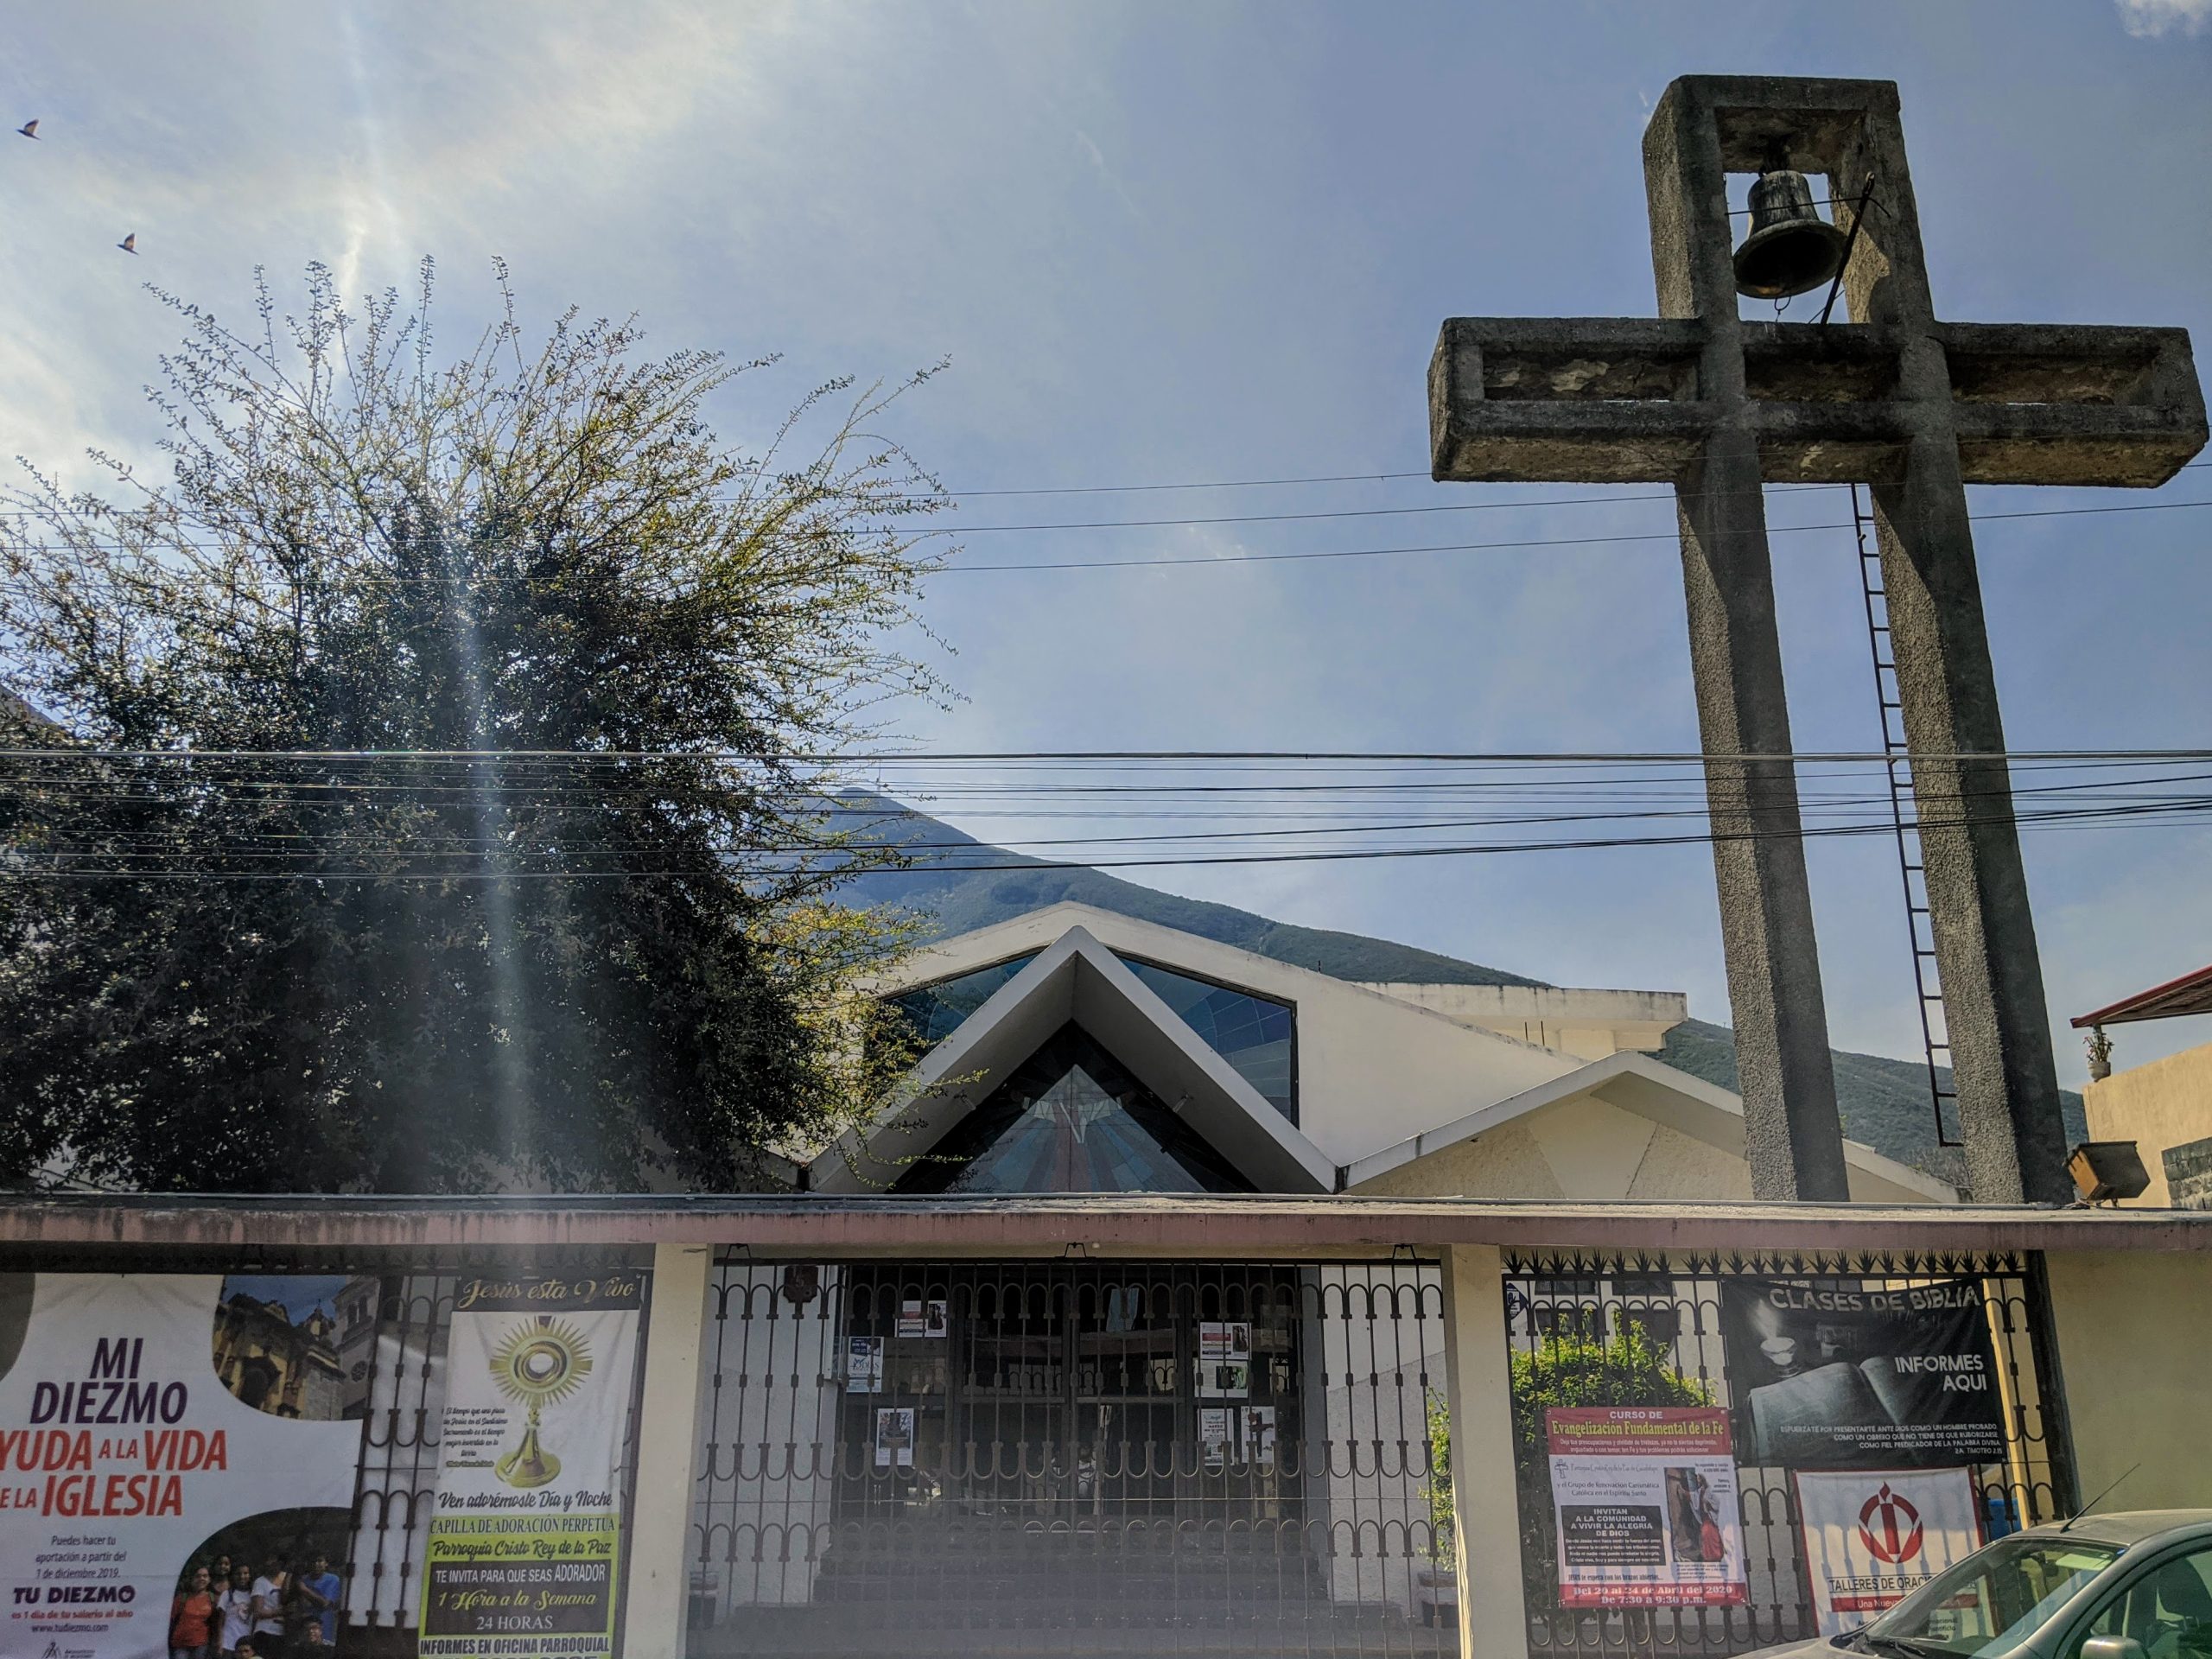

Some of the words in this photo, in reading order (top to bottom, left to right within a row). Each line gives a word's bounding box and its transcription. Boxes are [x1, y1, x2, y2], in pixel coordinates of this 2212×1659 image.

[527, 1279, 568, 1299] esta
[574, 1276, 636, 1303] Vivo
[1770, 1288, 1864, 1312] CLASES
[1870, 1294, 1904, 1311] DE
[1909, 1285, 1980, 1310] BIBLIA
[89, 1338, 143, 1379] MI
[1894, 1354, 1984, 1373] INFORMES
[1942, 1374, 1986, 1392] AQUI
[29, 1382, 188, 1424] DIEZMO
[1610, 1411, 1646, 1420] CURSO
[1552, 1421, 1623, 1438] Evangelización
[1624, 1421, 1687, 1435] Fundamental
[1689, 1421, 1700, 1434] de
[1702, 1421, 1711, 1434] la
[1713, 1421, 1724, 1434] Fe
[0, 1430, 92, 1471] YUDA
[98, 1439, 111, 1459] A
[116, 1439, 138, 1459] LA
[144, 1430, 227, 1471] VIDA
[0, 1488, 11, 1508] E
[14, 1488, 37, 1508] LA
[41, 1475, 182, 1516] IGLESIA
[438, 1491, 465, 1509] Ven
[467, 1491, 537, 1508] adorémosle
[539, 1491, 562, 1508] Día
[563, 1495, 573, 1511] y
[575, 1491, 613, 1506] Noche
[430, 1519, 475, 1534] CAPILLA
[478, 1519, 492, 1533] DE
[494, 1514, 559, 1533] ADORACIÓN
[563, 1517, 615, 1532] PERPETUA
[51, 1535, 81, 1546] Puedes
[83, 1535, 105, 1545] hacer
[107, 1536, 117, 1545] tu
[433, 1541, 493, 1561] Parroquia
[494, 1540, 530, 1555] Cristo
[532, 1540, 556, 1560] Rey
[558, 1540, 572, 1554] de
[574, 1539, 584, 1554] la
[587, 1538, 612, 1554] Paz
[88, 1553, 112, 1563] partir
[113, 1551, 128, 1561] del
[36, 1569, 41, 1579] 1
[42, 1568, 54, 1579] de
[435, 1570, 447, 1583] TE
[448, 1570, 479, 1583] INVITA
[480, 1569, 505, 1582] PARA
[507, 1569, 526, 1582] QUE
[528, 1569, 552, 1582] SEAS
[554, 1564, 605, 1581] ADORADOR
[1573, 1586, 1591, 1595] Del
[1592, 1586, 1608, 1595] 20
[1687, 1586, 1703, 1594] del
[1707, 1586, 1732, 1594] 2020
[1829, 1579, 1878, 1591] TALLERES
[1882, 1578, 1894, 1589] DE
[14, 1587, 41, 1604] TU
[48, 1585, 136, 1604] DIEZMO
[438, 1592, 447, 1606] 1
[451, 1589, 499, 1611] Hora
[499, 1597, 510, 1606] a
[513, 1590, 530, 1606] la
[533, 1590, 597, 1611] Semana
[1682, 1597, 1707, 1606] p.m.
[476, 1616, 493, 1630] 24
[498, 1615, 553, 1630] HORAS
[420, 1639, 475, 1655] INFORMES
[478, 1638, 492, 1653] EN
[493, 1638, 537, 1653] OFICINA
[539, 1637, 610, 1653] PARROQUIAL
